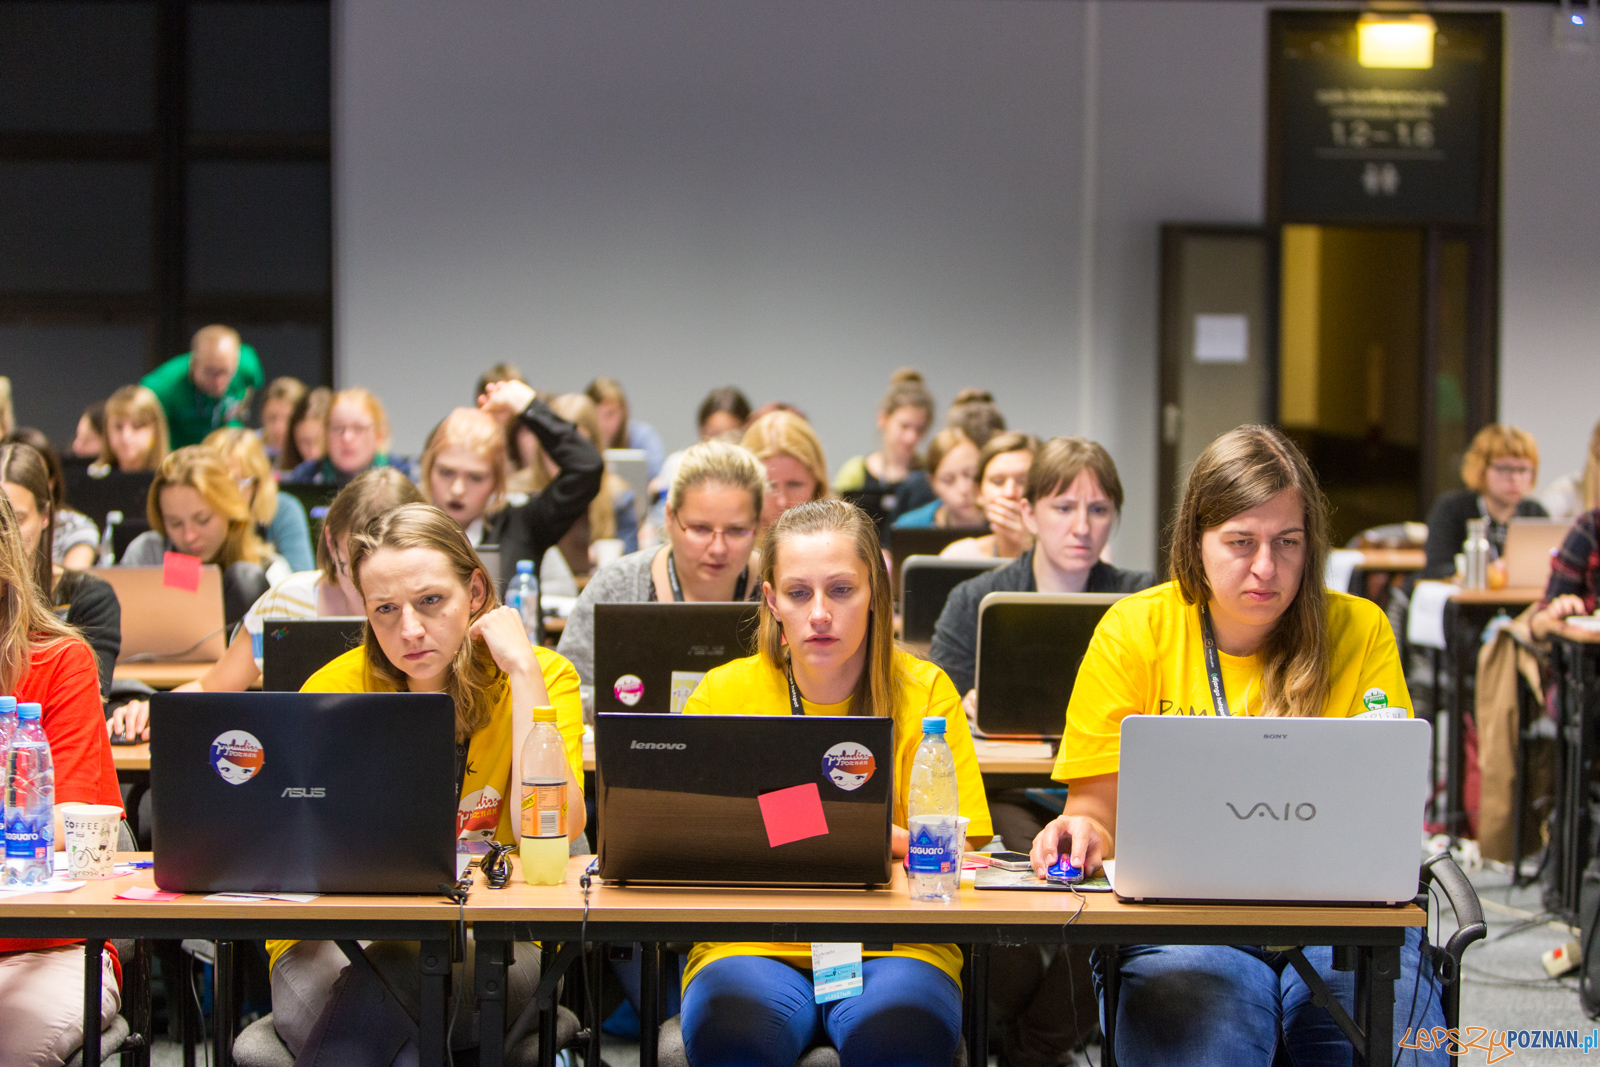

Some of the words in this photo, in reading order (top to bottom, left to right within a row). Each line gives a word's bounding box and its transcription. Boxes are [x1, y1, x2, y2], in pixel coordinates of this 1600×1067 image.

[1212, 676, 1221, 697] django
[630, 740, 687, 750] lenovo
[281, 787, 326, 798] ASUS
[1226, 802, 1316, 821] VAIO
[65, 820, 99, 830] COFFEE
[909, 846, 944, 855] saguaro
